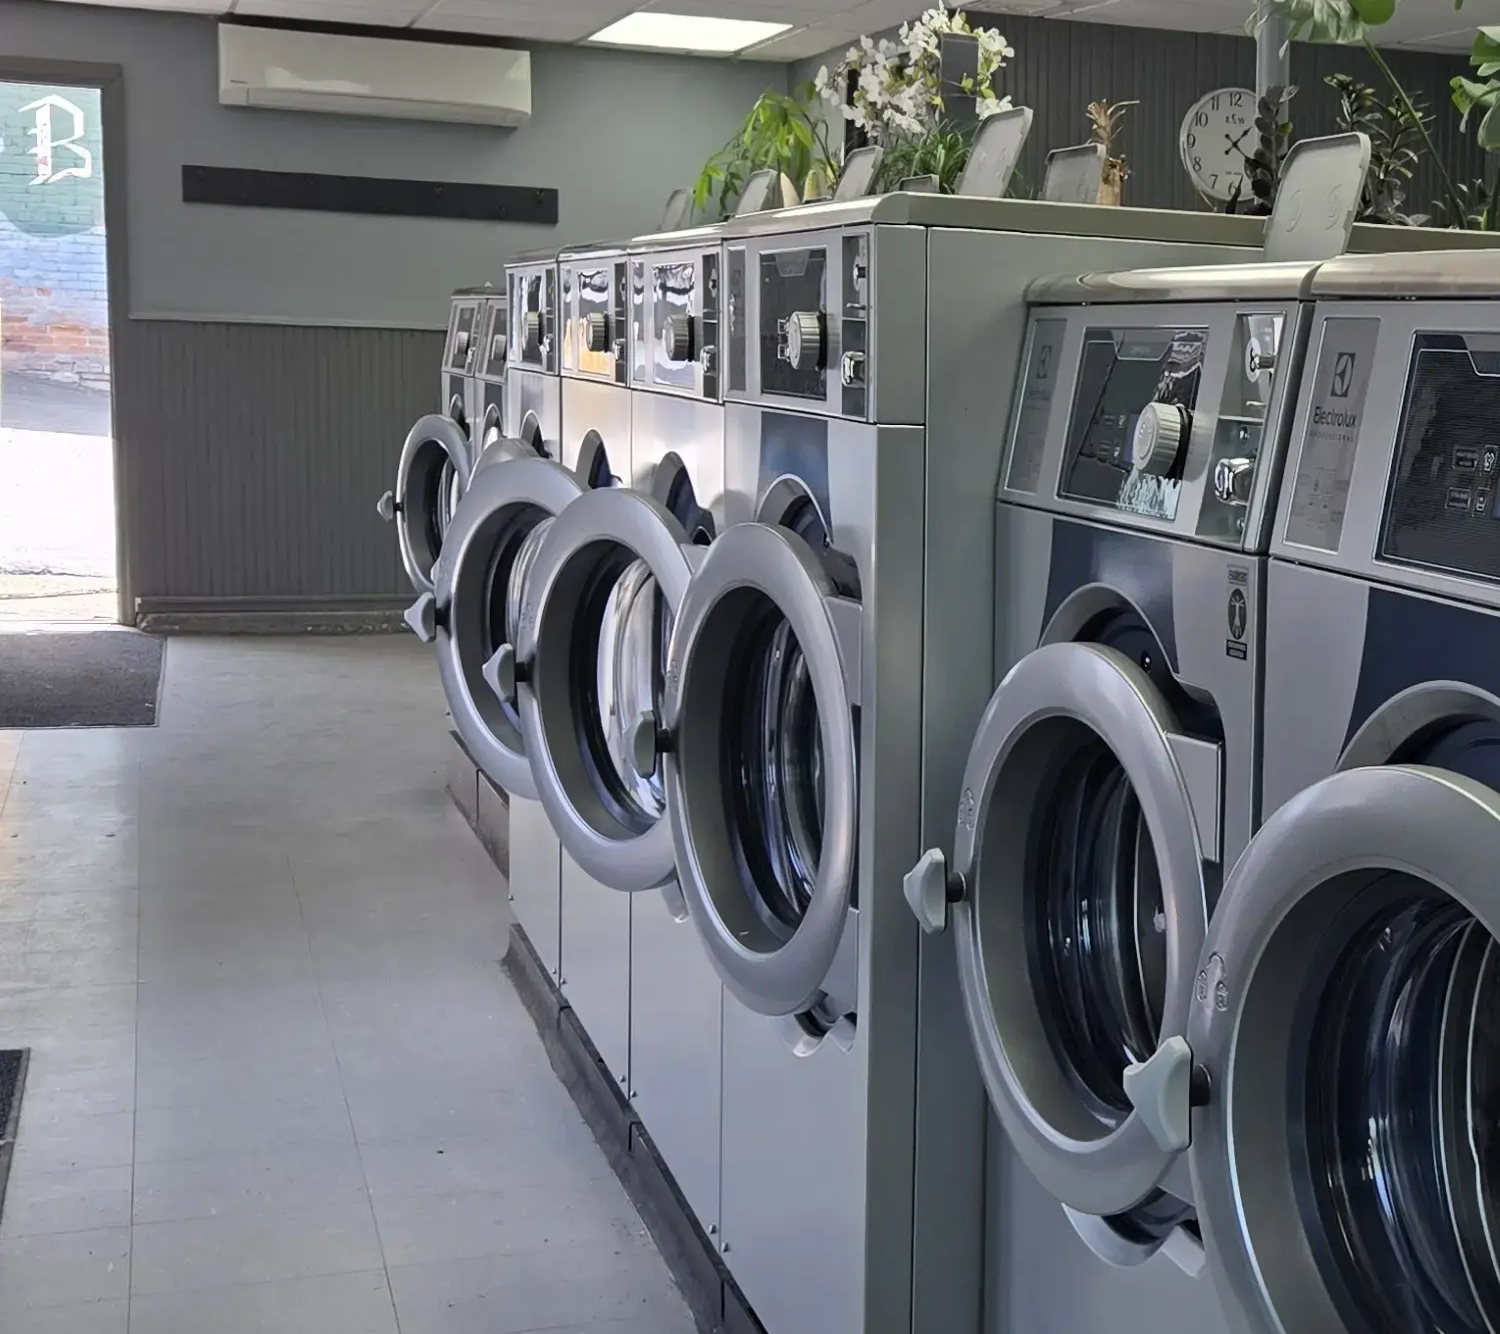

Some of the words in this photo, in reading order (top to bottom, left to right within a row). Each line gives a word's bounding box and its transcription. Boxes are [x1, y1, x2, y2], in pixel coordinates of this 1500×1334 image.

[1210, 95, 1220, 111] 11
[1229, 91, 1243, 107] 12
[1195, 110, 1208, 127] 10
[18, 94, 92, 185] B
[1187, 133, 1196, 149] 9
[1193, 156, 1202, 172] 8
[1209, 174, 1218, 189] 7
[1228, 181, 1238, 196] 6
[1313, 406, 1357, 428] Electrolux
